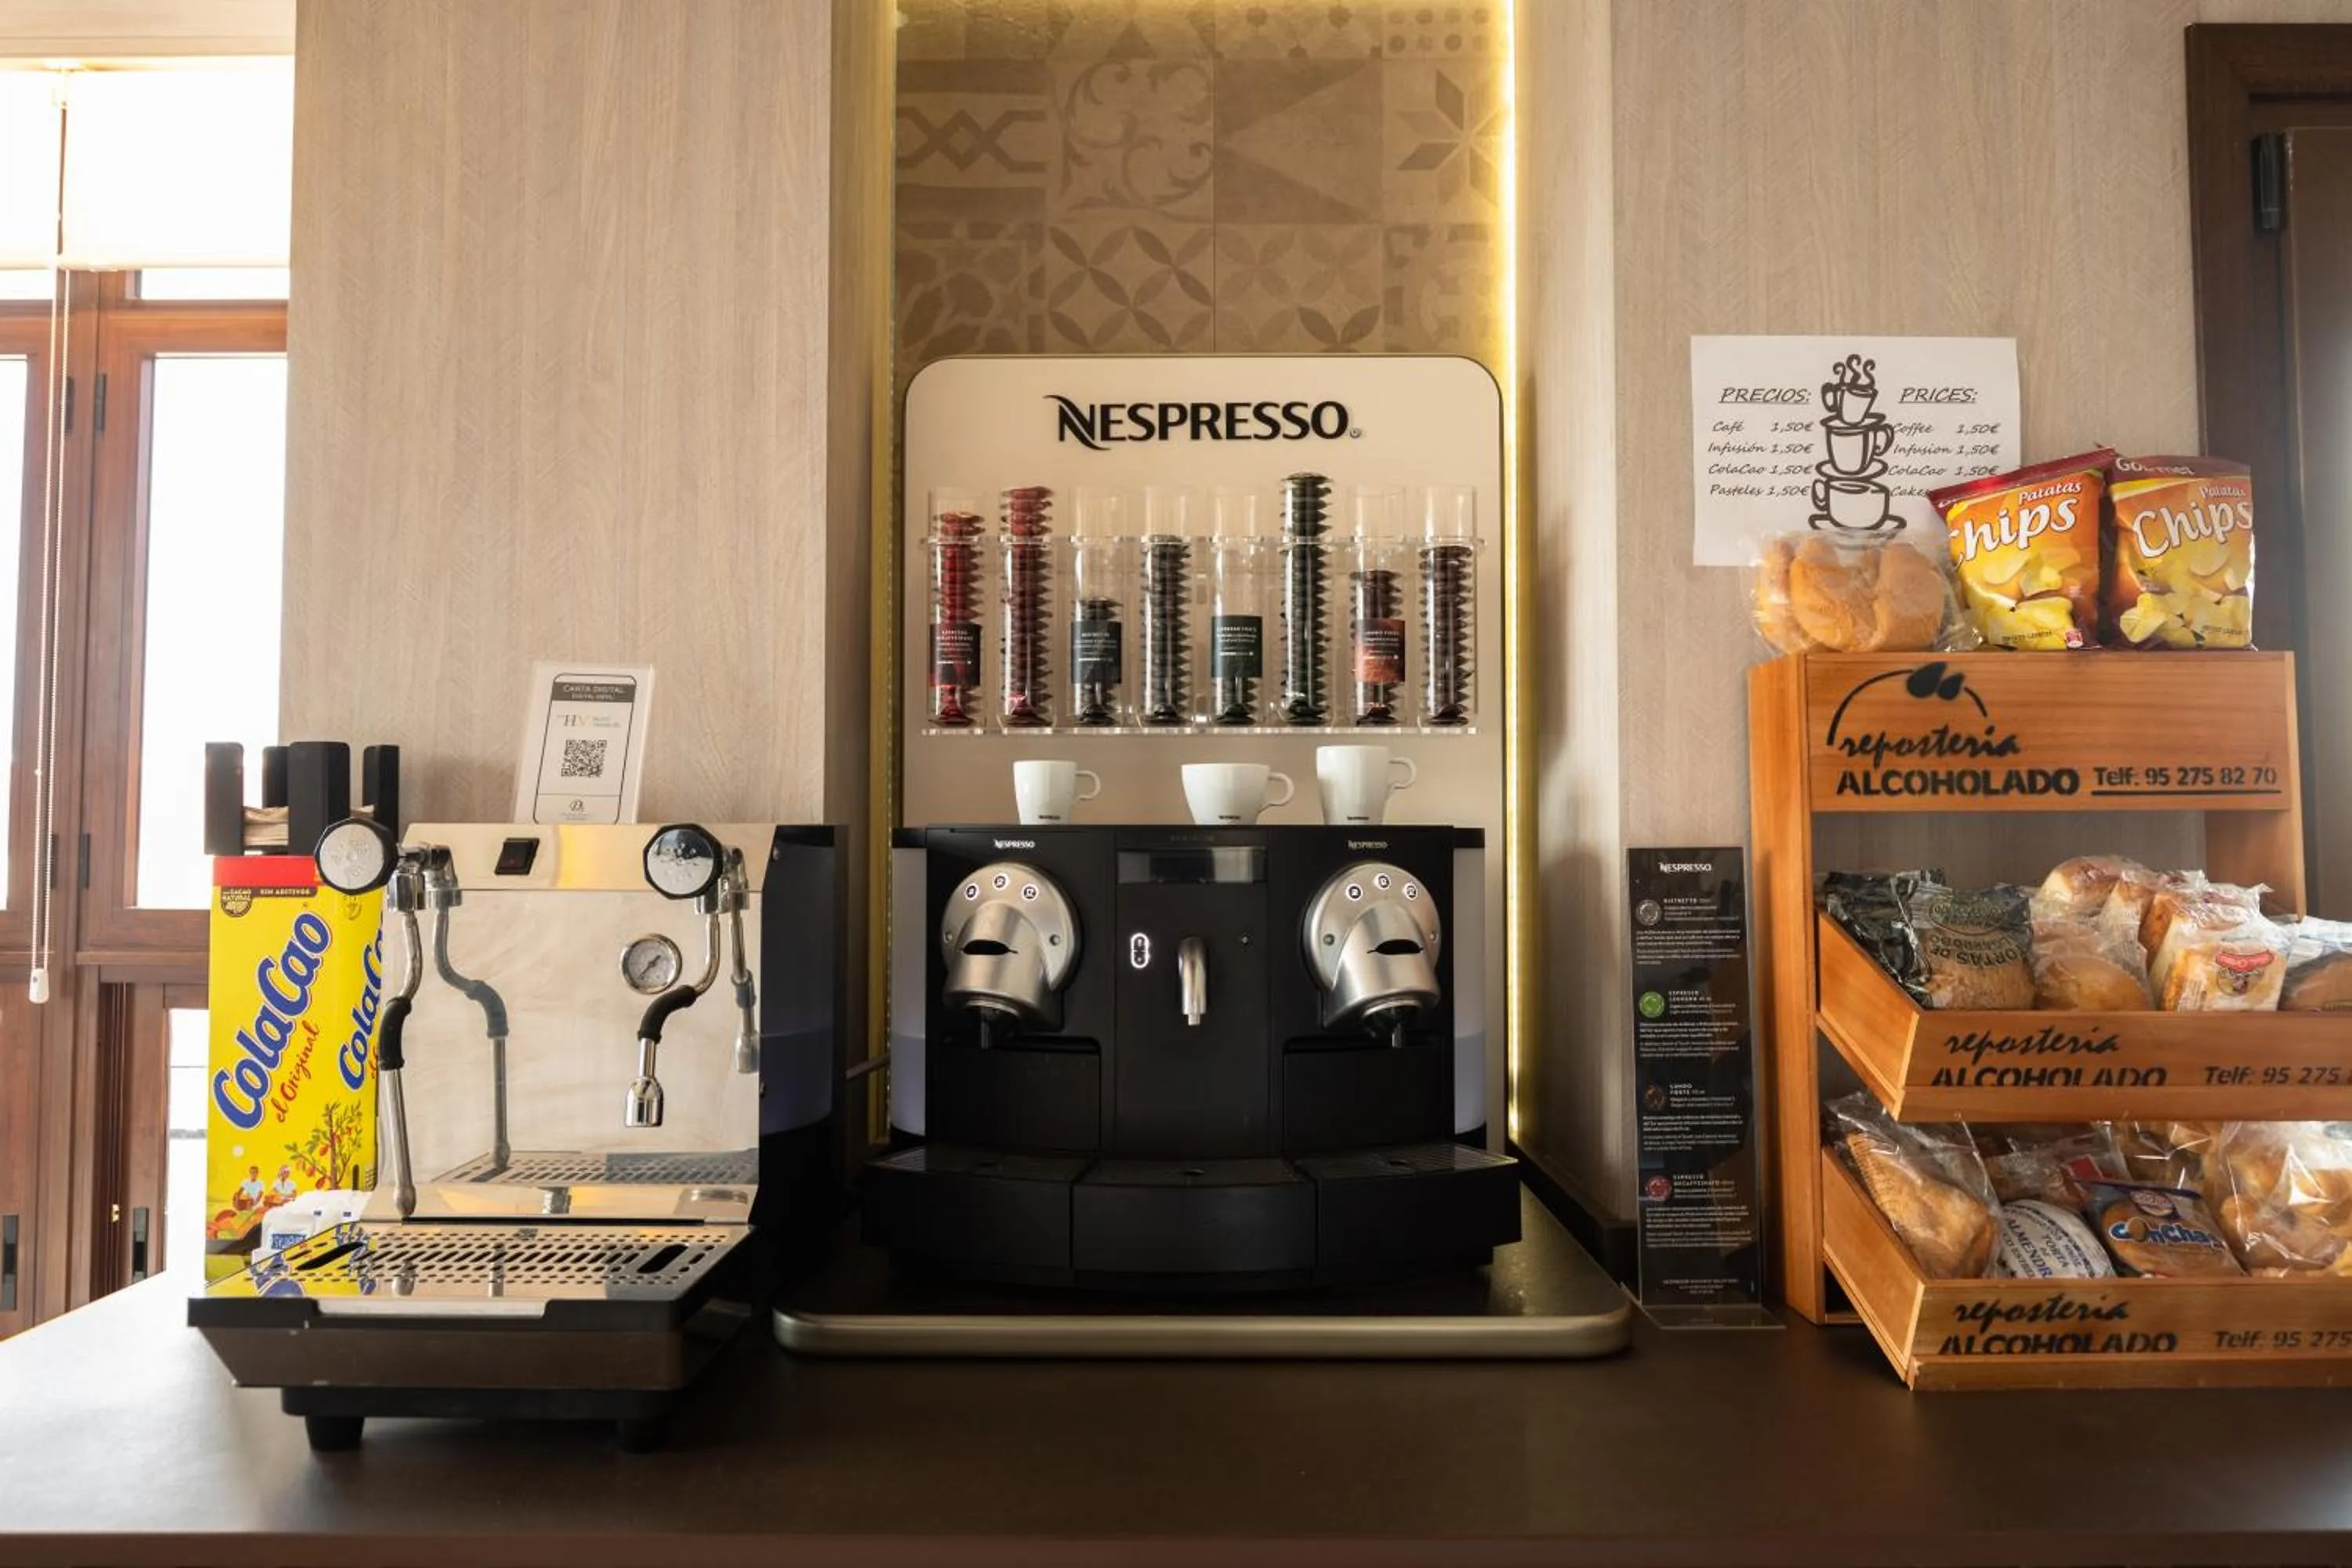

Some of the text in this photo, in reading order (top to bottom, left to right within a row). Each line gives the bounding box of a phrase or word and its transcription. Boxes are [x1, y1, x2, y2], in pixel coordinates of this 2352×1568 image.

[1719, 387, 1812, 405] PRECIOS:
[1899, 387, 1978, 404] PRICES:
[1043, 394, 1350, 450] NESPRESSO
[1712, 420, 1814, 434] Café 1,50€
[1893, 423, 2001, 436] Coffee 1,50€
[1708, 441, 1814, 456] Infusión 1,50€
[1893, 443, 2001, 457] Infusion 1,50€
[1708, 463, 1814, 476] ColaCao 1,50€
[1889, 465, 1998, 477] ColaCao 1,50€
[1710, 483, 1811, 497] Pasteles 1,50€
[2019, 481, 2082, 504] Patatas
[1950, 498, 2079, 568] hips
[2132, 501, 2254, 558] Chips
[1836, 768, 2080, 796] ALCOHOLADO
[2145, 767, 2170, 786] 95
[2177, 767, 2214, 786] 275
[2220, 767, 2245, 785] 82
[2252, 767, 2278, 785] 70
[993, 838, 1036, 849] NESPRESSO
[1658, 862, 1712, 873] NESPRESSO
[339, 910, 383, 1092] ColaC
[213, 912, 332, 1130] ColaCao
[270, 1020, 320, 1124] el Original
[1931, 1067, 2169, 1087] ALCOHOLADO
[2261, 1066, 2292, 1085] 95
[2298, 1066, 2343, 1085] 275
[1937, 1332, 2180, 1356] ALCOHOLADO
[2274, 1330, 2303, 1348] 95
[2310, 1330, 2352, 1348] 275
